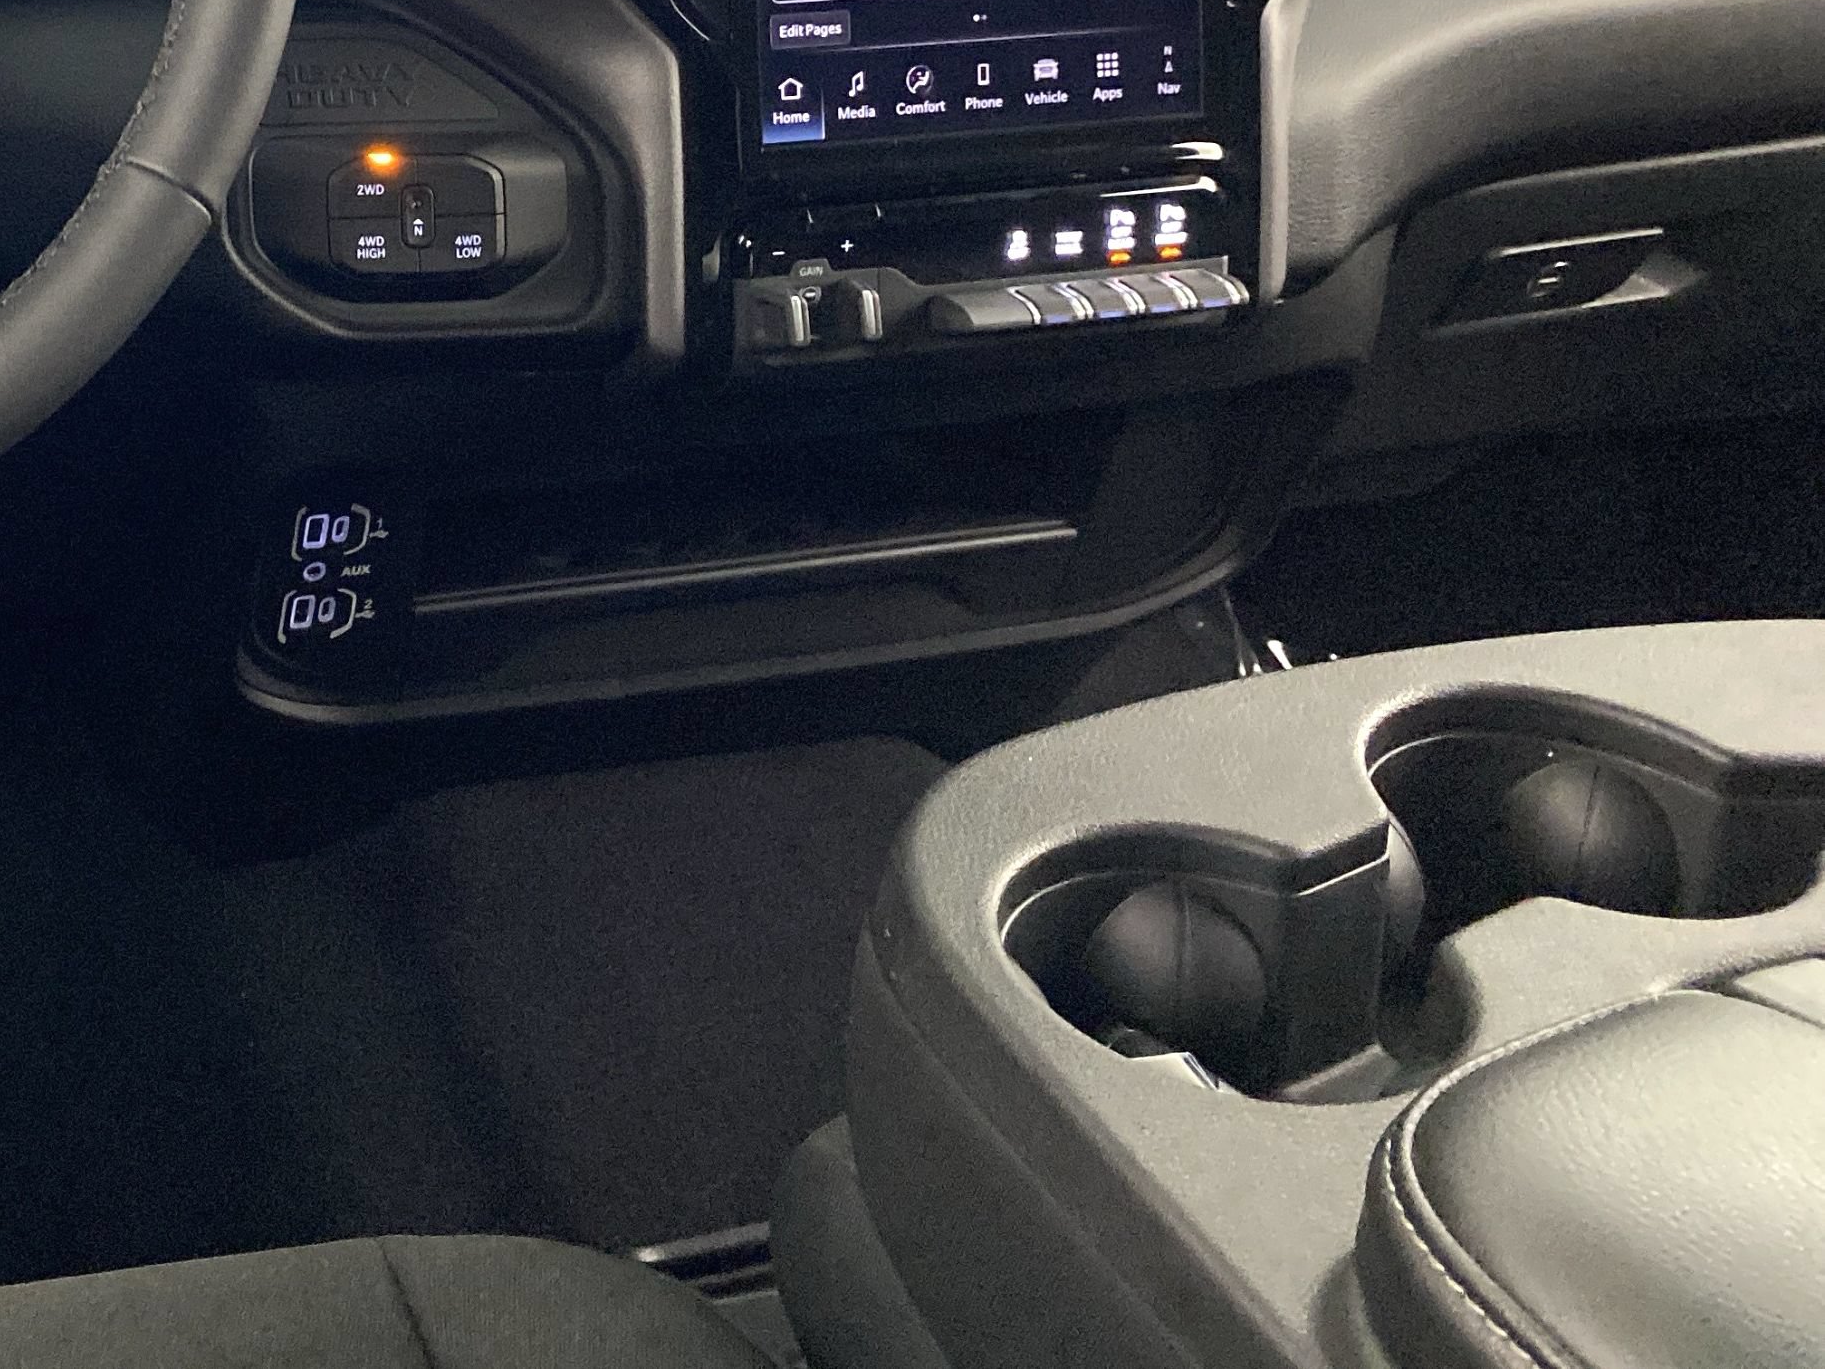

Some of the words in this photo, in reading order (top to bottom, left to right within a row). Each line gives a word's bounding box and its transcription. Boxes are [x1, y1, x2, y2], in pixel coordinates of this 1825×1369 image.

[779, 23, 805, 38] Edit
[806, 22, 842, 39] Pages
[1093, 86, 1123, 102] Apps
[1157, 82, 1182, 95] Nav
[965, 96, 1003, 111] Phone
[1025, 90, 1068, 105] Vehicle
[838, 105, 875, 120] Media
[896, 101, 946, 115] Comfort
[773, 111, 810, 124] Home
[357, 184, 385, 197] 2WD
[413, 225, 423, 236] N
[358, 236, 384, 247] 4WD
[455, 235, 481, 246] 4WD
[357, 248, 386, 260] HIGH
[456, 247, 482, 259] LOW
[799, 267, 823, 277] GAIN
[341, 564, 370, 576] AUX
